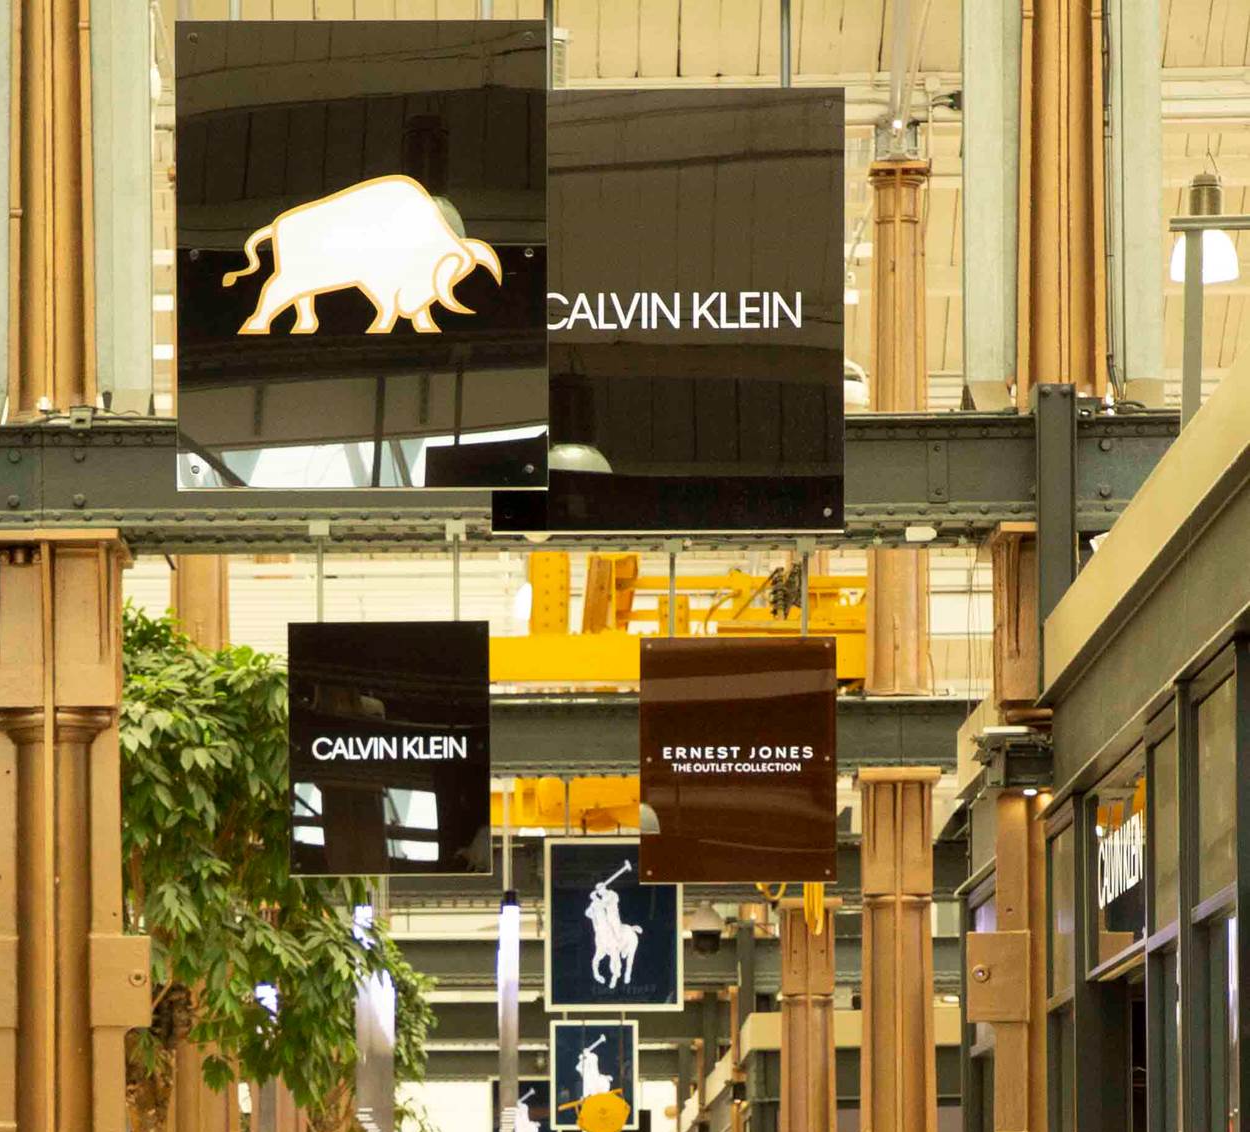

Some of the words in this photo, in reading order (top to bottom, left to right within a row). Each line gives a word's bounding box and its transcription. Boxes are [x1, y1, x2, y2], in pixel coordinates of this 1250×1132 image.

[547, 292, 681, 330] CALVIN
[693, 291, 802, 329] KLEIN
[312, 737, 398, 760] CALVIN
[402, 736, 467, 759] KLEIN
[662, 746, 741, 760] ERNEST
[749, 746, 814, 759] JONES
[671, 763, 692, 773] THE
[693, 763, 734, 773] OUTLET
[734, 763, 802, 773] COLLECTION
